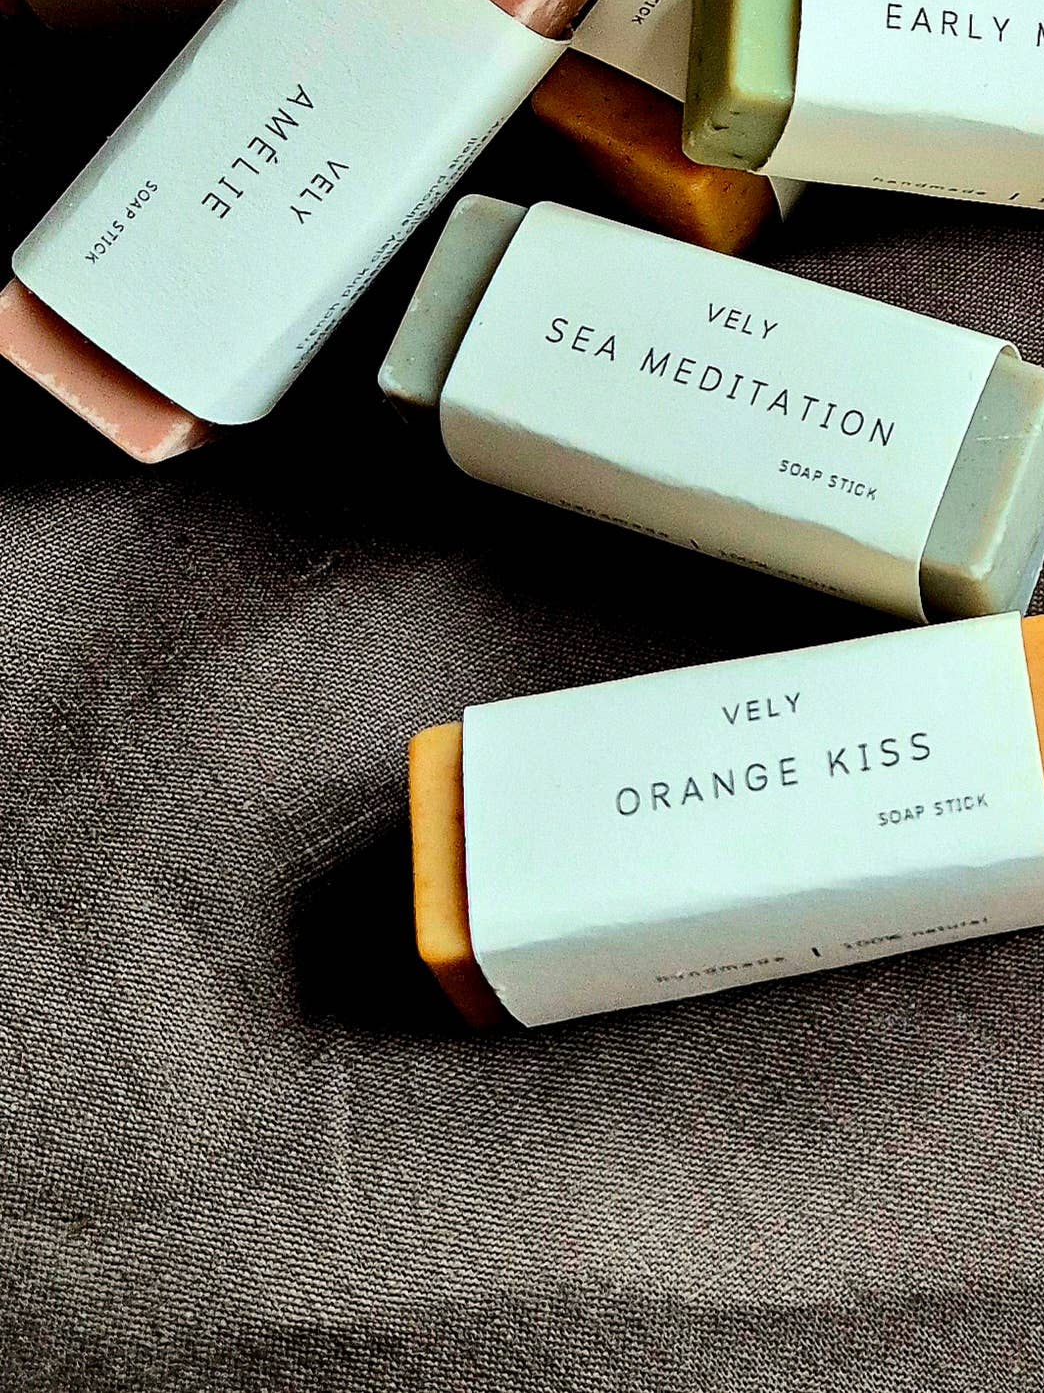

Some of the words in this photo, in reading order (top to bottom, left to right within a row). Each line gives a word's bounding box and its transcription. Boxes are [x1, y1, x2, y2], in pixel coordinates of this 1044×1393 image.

[886, 3, 1010, 42] EARLY
[201, 84, 315, 220] AMÉLIE
[126, 180, 159, 221] SOAP
[290, 161, 349, 224] VELY
[85, 219, 125, 264] STICK
[709, 303, 778, 339] VELY
[545, 318, 615, 361] SEA
[640, 347, 894, 446] MEDITATION
[779, 460, 823, 481] SOAP
[828, 475, 877, 500] STICK
[722, 692, 800, 725] VELY
[617, 757, 798, 816] ORANGE
[828, 733, 930, 776] KISS
[878, 805, 924, 827] SOAP
[934, 794, 988, 816] STICK
